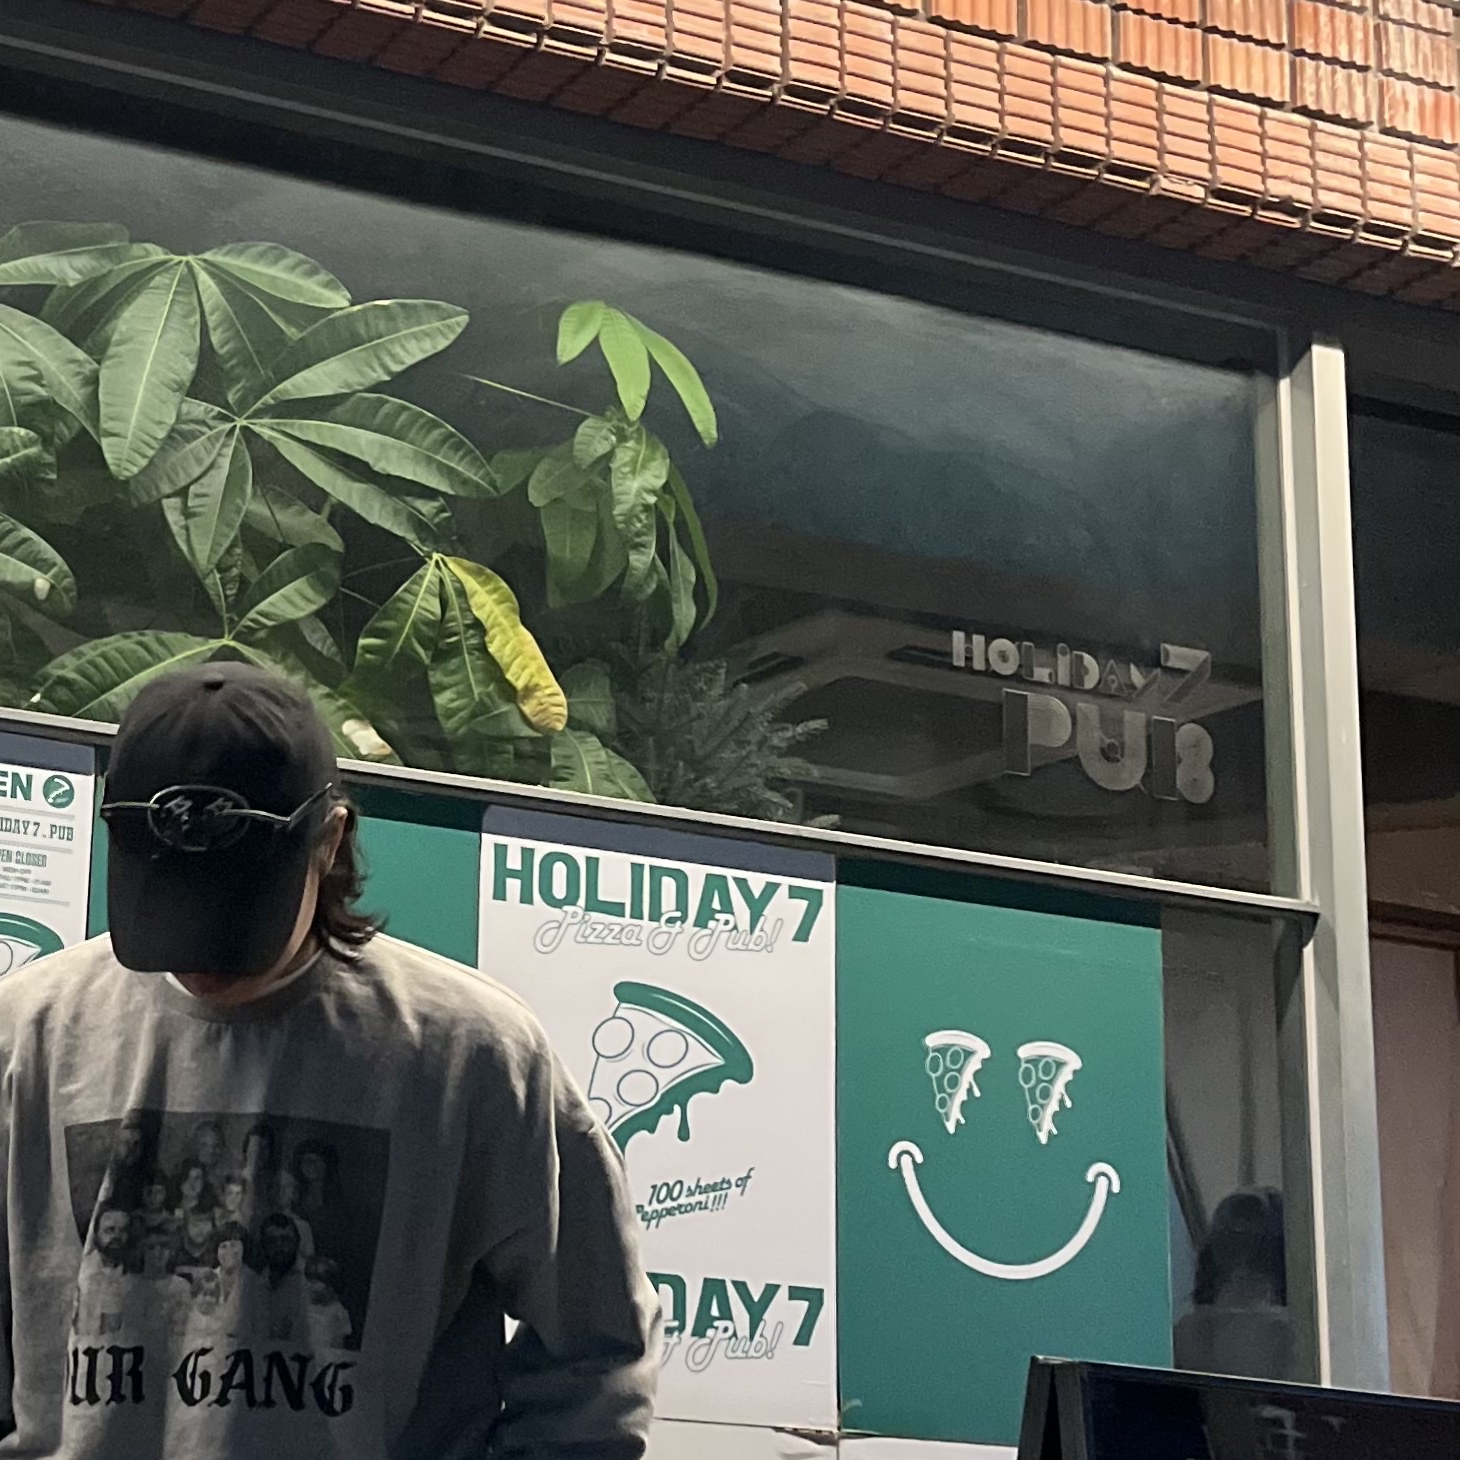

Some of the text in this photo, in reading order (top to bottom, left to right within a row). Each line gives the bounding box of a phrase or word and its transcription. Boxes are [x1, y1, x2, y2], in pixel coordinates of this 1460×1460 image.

[952, 630, 1161, 699] HOLIDAY
[1003, 687, 1215, 805] PUB
[493, 843, 824, 943] HOLIDAY 7
[533, 904, 784, 961] Pizza & Pub!
[647, 1167, 756, 1207] 100 sheets of
[685, 1319, 784, 1373] Pub!
[788, 1285, 825, 1347] 7
[172, 1346, 357, 1417] GANG
